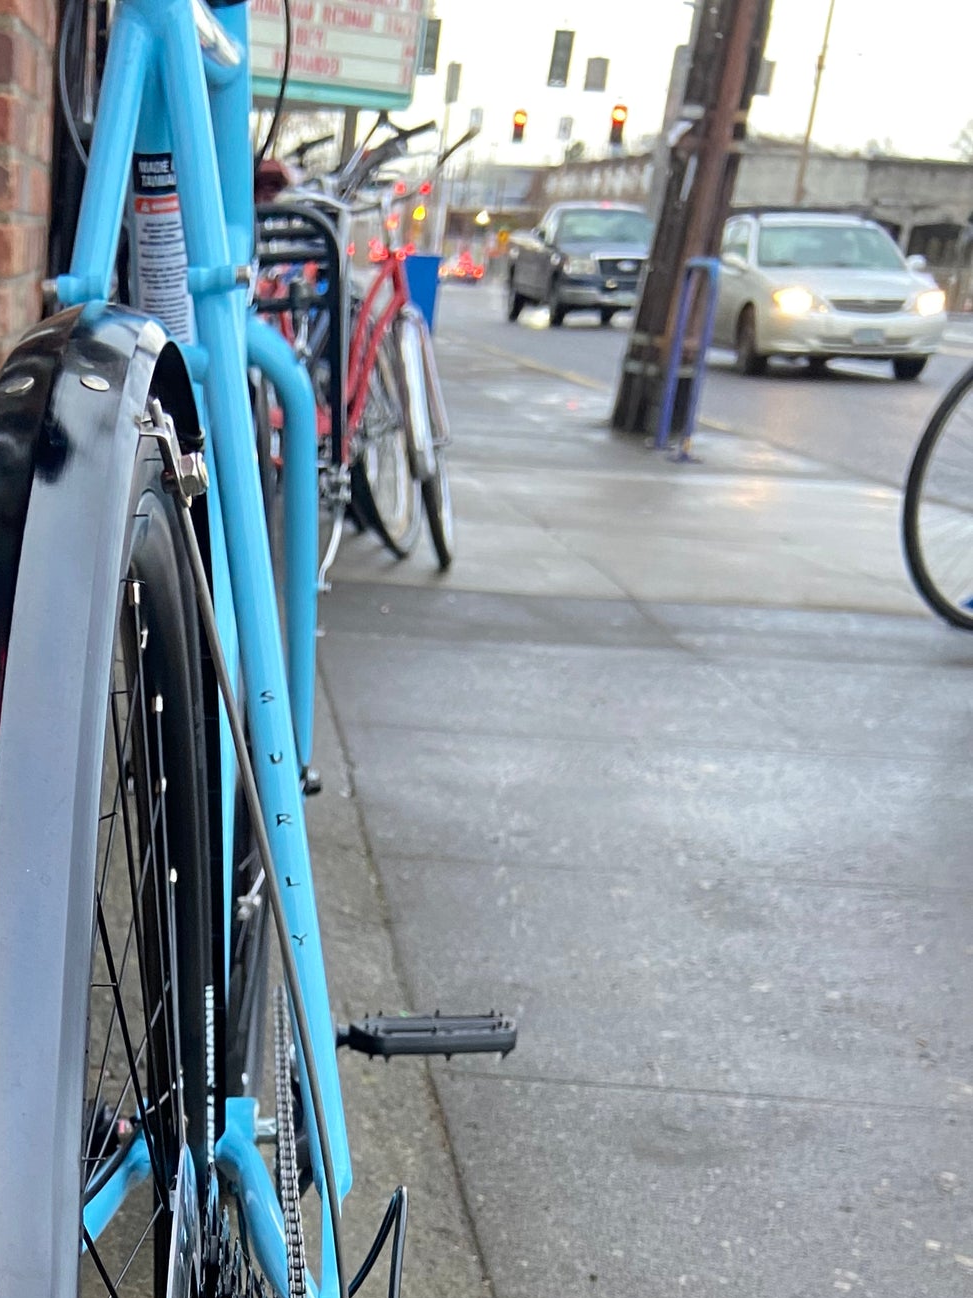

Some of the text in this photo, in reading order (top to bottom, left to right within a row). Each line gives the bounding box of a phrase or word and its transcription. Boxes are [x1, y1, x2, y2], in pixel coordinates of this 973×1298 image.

[138, 160, 170, 173] MADE
[141, 173, 177, 187] TAIWA
[260, 690, 308, 946] SURLY
